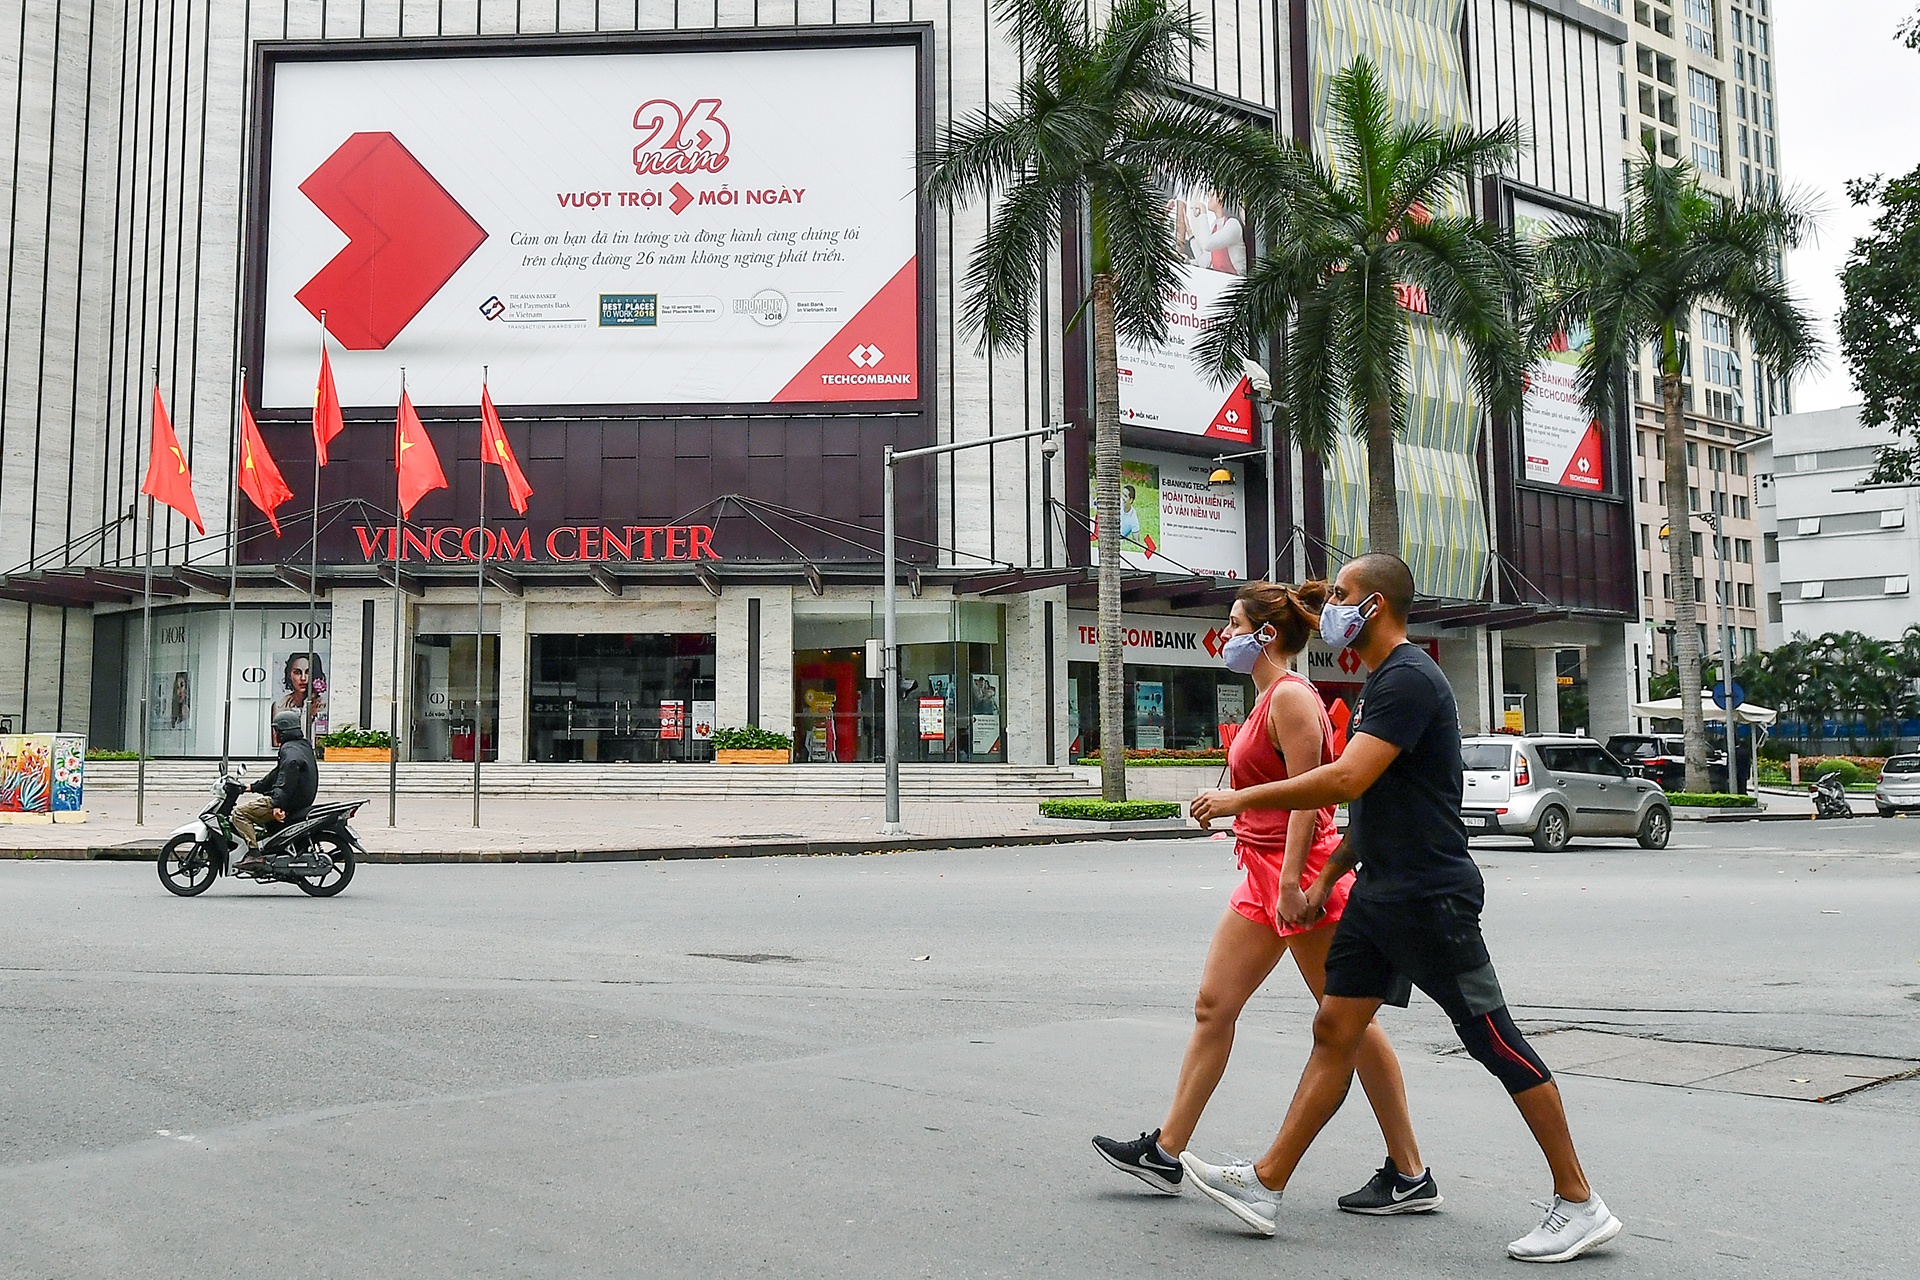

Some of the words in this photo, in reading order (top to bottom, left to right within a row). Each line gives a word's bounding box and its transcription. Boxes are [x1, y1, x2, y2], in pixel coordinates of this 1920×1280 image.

[633, 98, 731, 165] 26
[637, 139, 730, 175] năm
[557, 190, 612, 211] VƯỢT
[618, 188, 662, 210] TRỘI
[699, 183, 739, 206] MỖI
[746, 185, 806, 205] NGÀY
[510, 231, 540, 245] Cảm
[544, 233, 559, 244] ơn
[563, 231, 587, 246] bạn
[591, 230, 608, 244] đã
[612, 230, 629, 244] tin
[634, 230, 670, 248] tưởng
[674, 230, 691, 243] và
[694, 228, 727, 247] đồng
[730, 228, 762, 242] hành
[766, 229, 798, 246] cùng
[801, 226, 840, 245] chúng
[843, 225, 861, 240] tôi
[522, 253, 547, 266] trên
[551, 251, 589, 270] chặng
[592, 251, 632, 270] đường
[636, 250, 655, 265] 26
[658, 253, 687, 265] năm
[691, 249, 731, 268] không
[733, 251, 775, 268] ngừng
[776, 248, 808, 267] phát
[812, 247, 845, 262] triển.
[523, 302, 554, 311] Payments
[733, 299, 783, 310] EUROMONEY
[821, 374, 911, 385] TECHCOMBANK
[1162, 491, 1183, 501] HOÀN
[1184, 493, 1204, 505] TOÀN
[1190, 506, 1208, 518] NIỀM
[1209, 511, 1221, 520] VUI
[352, 526, 534, 561] VINCOM
[545, 525, 723, 561] CENTER
[161, 626, 186, 645] DIOR
[1078, 626, 1197, 650] TECOMBANK
